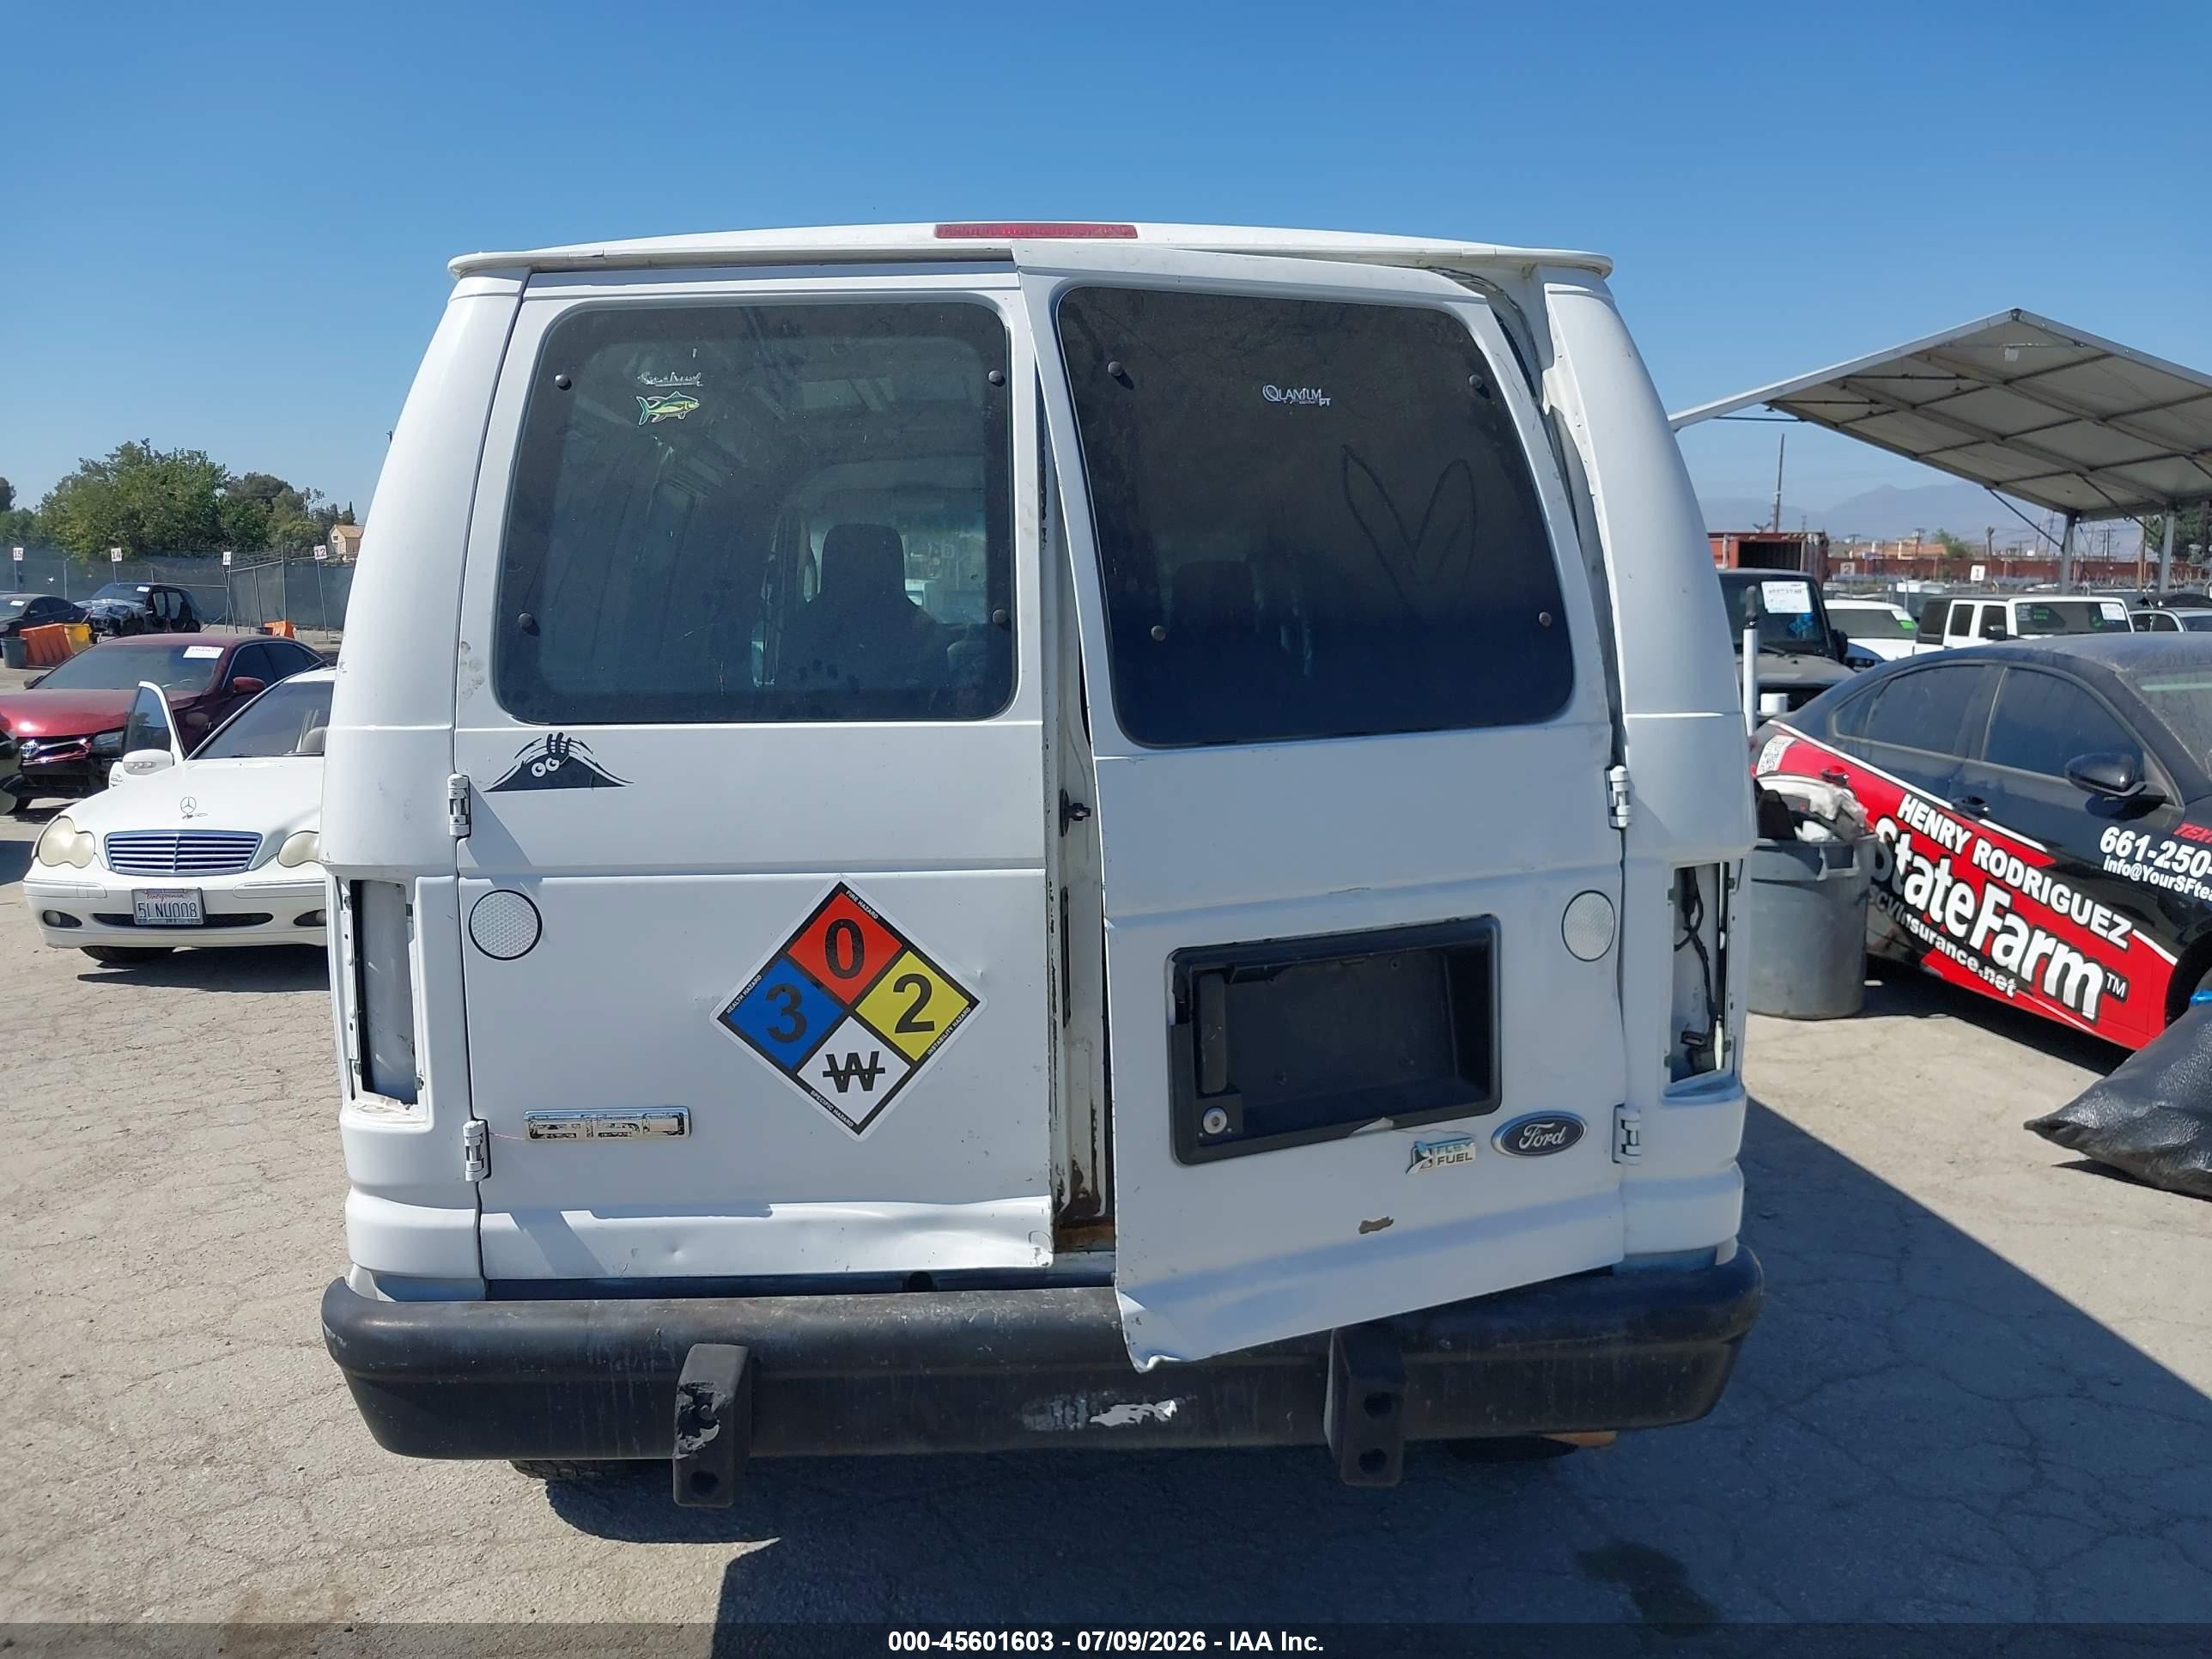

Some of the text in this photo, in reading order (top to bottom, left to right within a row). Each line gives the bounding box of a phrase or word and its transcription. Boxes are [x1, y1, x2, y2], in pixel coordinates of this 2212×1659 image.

[13, 550, 23, 559] 15
[112, 550, 121, 560] 14
[315, 548, 325, 557] 12
[1897, 793, 2132, 950] HENRY RODRIGUEZ
[846, 890, 879, 920] FIRE HAZARD
[824, 918, 865, 980] 0
[726, 975, 763, 1014] HEALTH HAZARD
[893, 973, 935, 1034] 2
[765, 983, 807, 1043] 3
[951, 1006, 971, 1028] HAZARD
[810, 1090, 854, 1127] SPECIFIC HAZARD
[1518, 1122, 1566, 1149] Ford
[1437, 1152, 1473, 1165] FUEL
